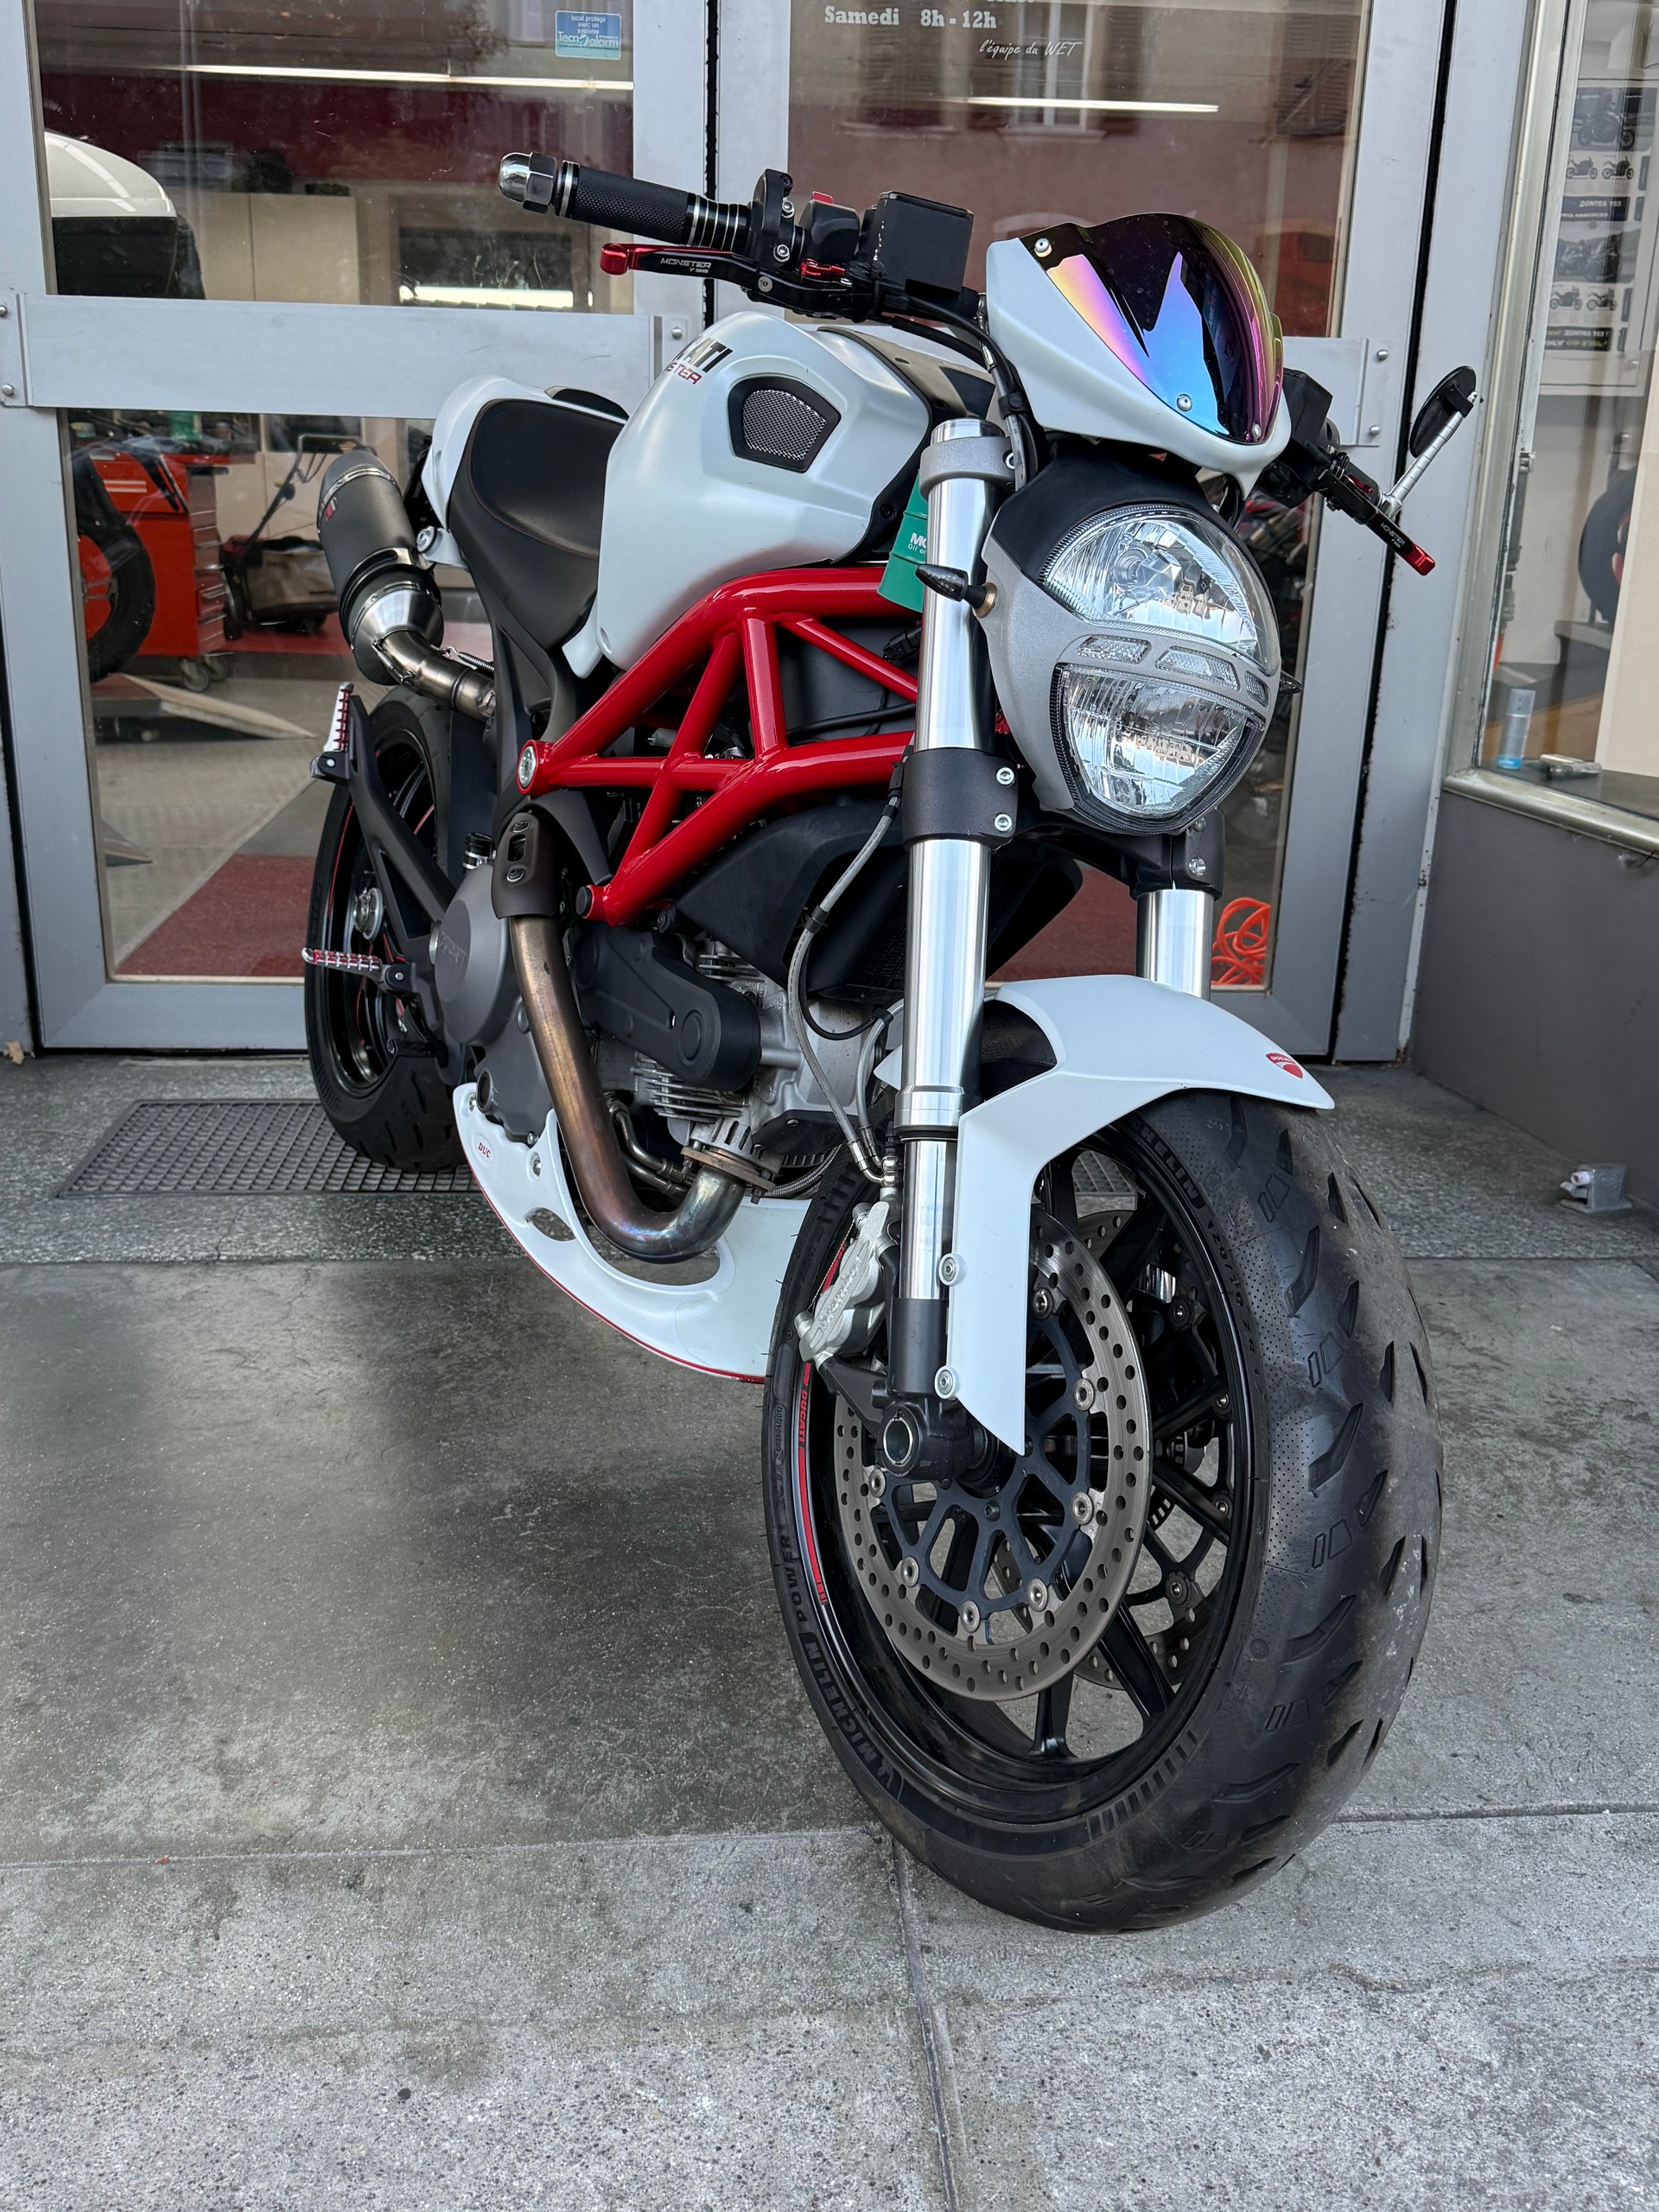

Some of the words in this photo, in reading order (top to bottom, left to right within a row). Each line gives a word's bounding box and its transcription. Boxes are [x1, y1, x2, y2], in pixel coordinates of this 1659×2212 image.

[824, 5, 899, 26] Samedi
[920, 10, 944, 28] 8h
[962, 10, 997, 29] 12h
[979, 40, 1021, 60] l'équipe
[1025, 42, 1039, 56] du
[1044, 41, 1083, 56] WET
[660, 257, 712, 270] MONSTER
[478, 1142, 491, 1159] DUC
[798, 1389, 808, 1444] DUCATI
[779, 1533, 808, 1623] POWER
[804, 1640, 879, 1764] MICHELIN
